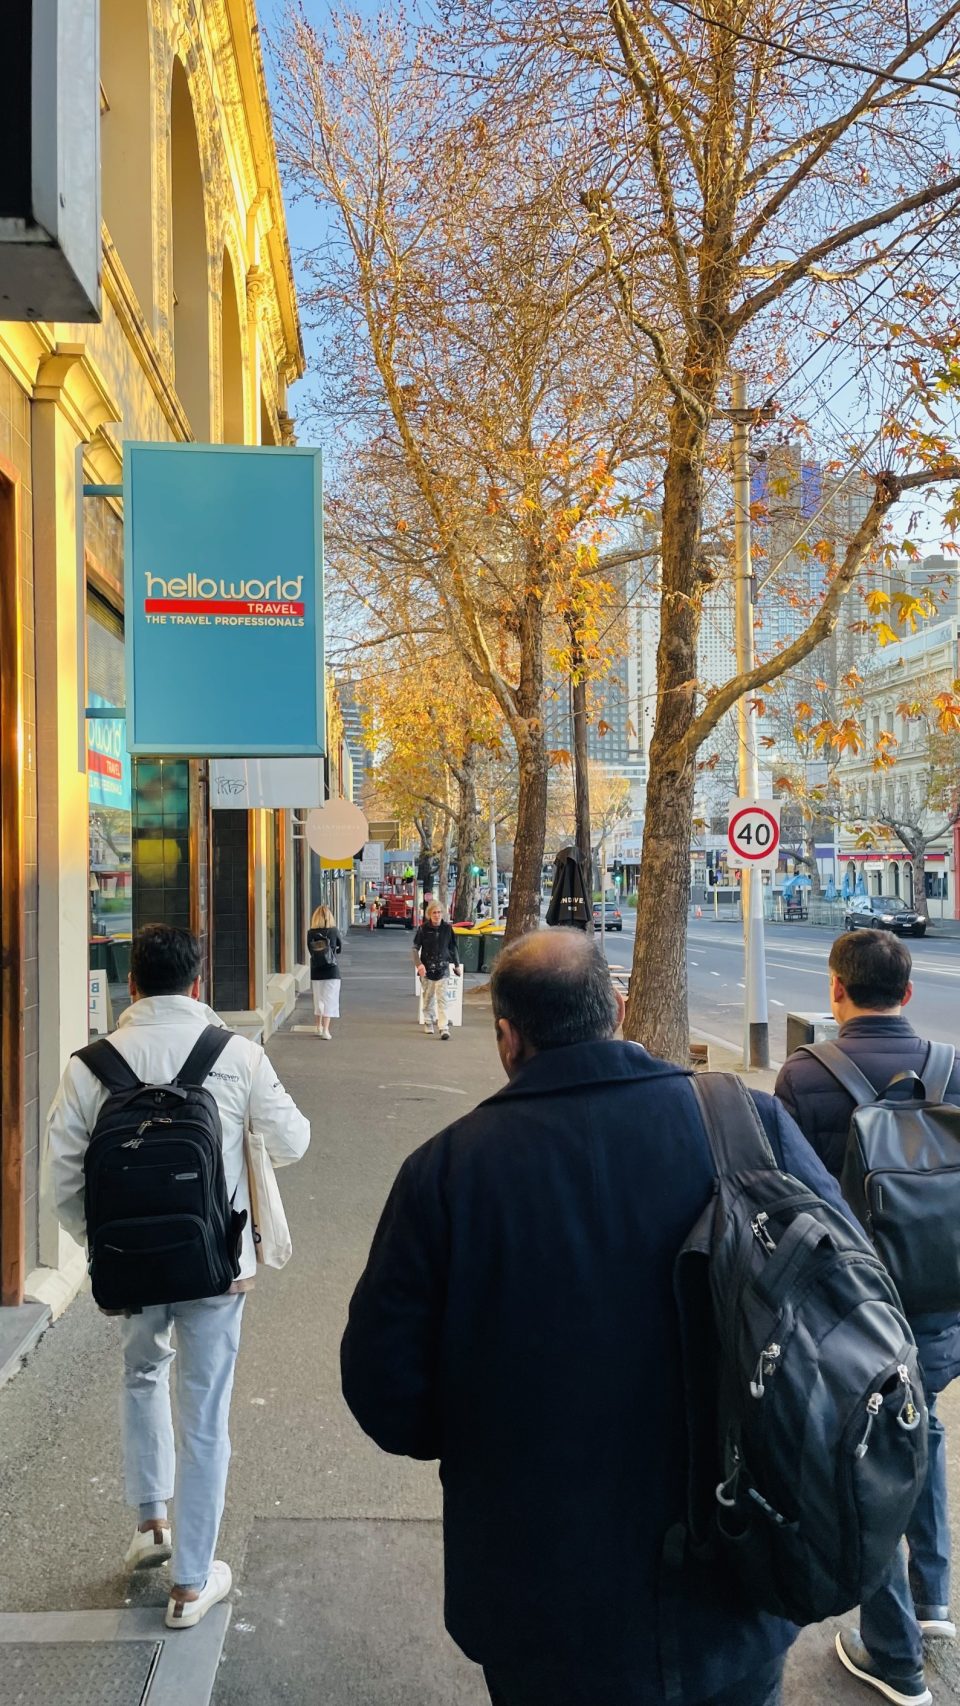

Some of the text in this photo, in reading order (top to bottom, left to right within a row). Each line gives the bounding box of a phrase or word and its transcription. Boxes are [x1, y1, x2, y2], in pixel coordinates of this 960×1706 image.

[247, 602, 297, 614] TRAVEL
[145, 615, 305, 627] THE TRAVEL PROFESSIONALS
[737, 823, 770, 846] 40
